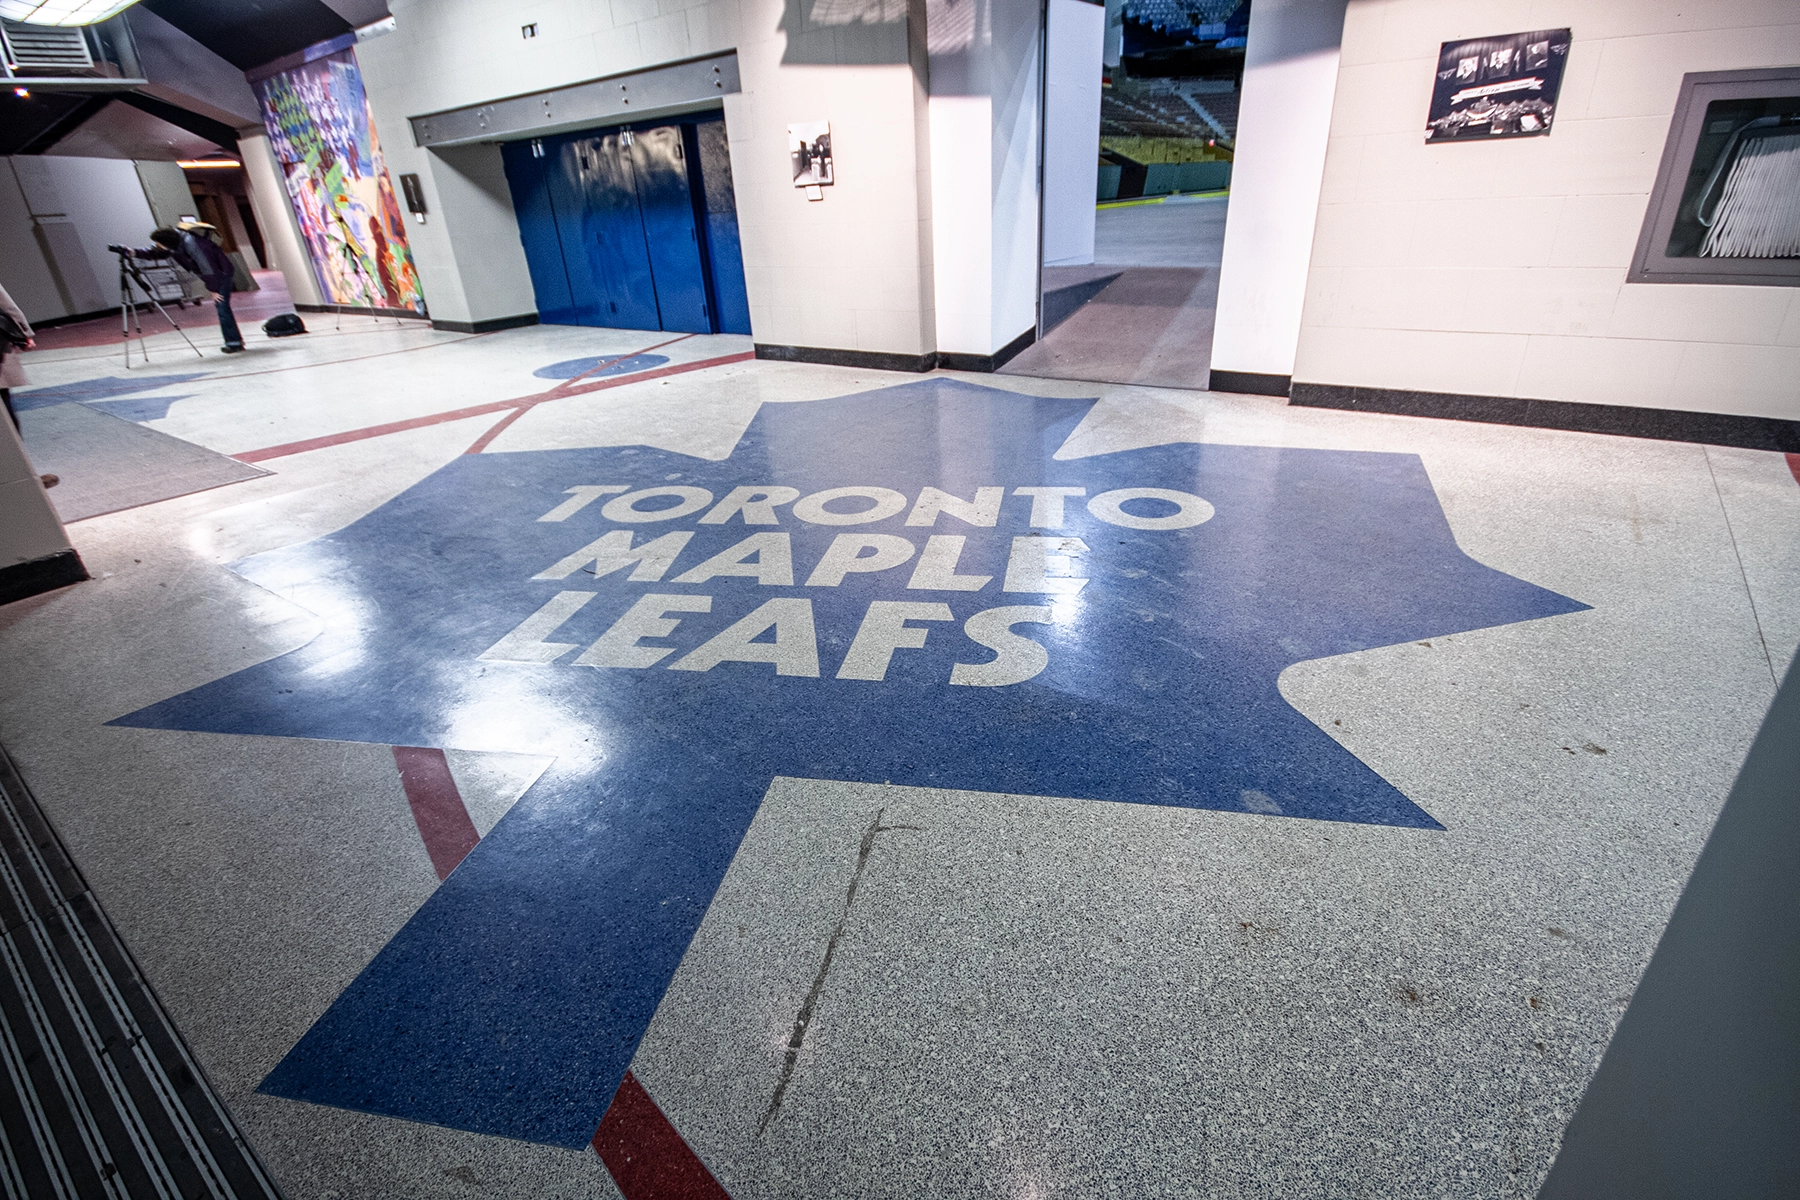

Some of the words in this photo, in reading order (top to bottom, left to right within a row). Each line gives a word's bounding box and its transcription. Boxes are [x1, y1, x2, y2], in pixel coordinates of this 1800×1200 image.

[538, 484, 1215, 530] TORONTO
[531, 530, 1090, 593] MAPLE
[477, 590, 1053, 687] LEAFS
